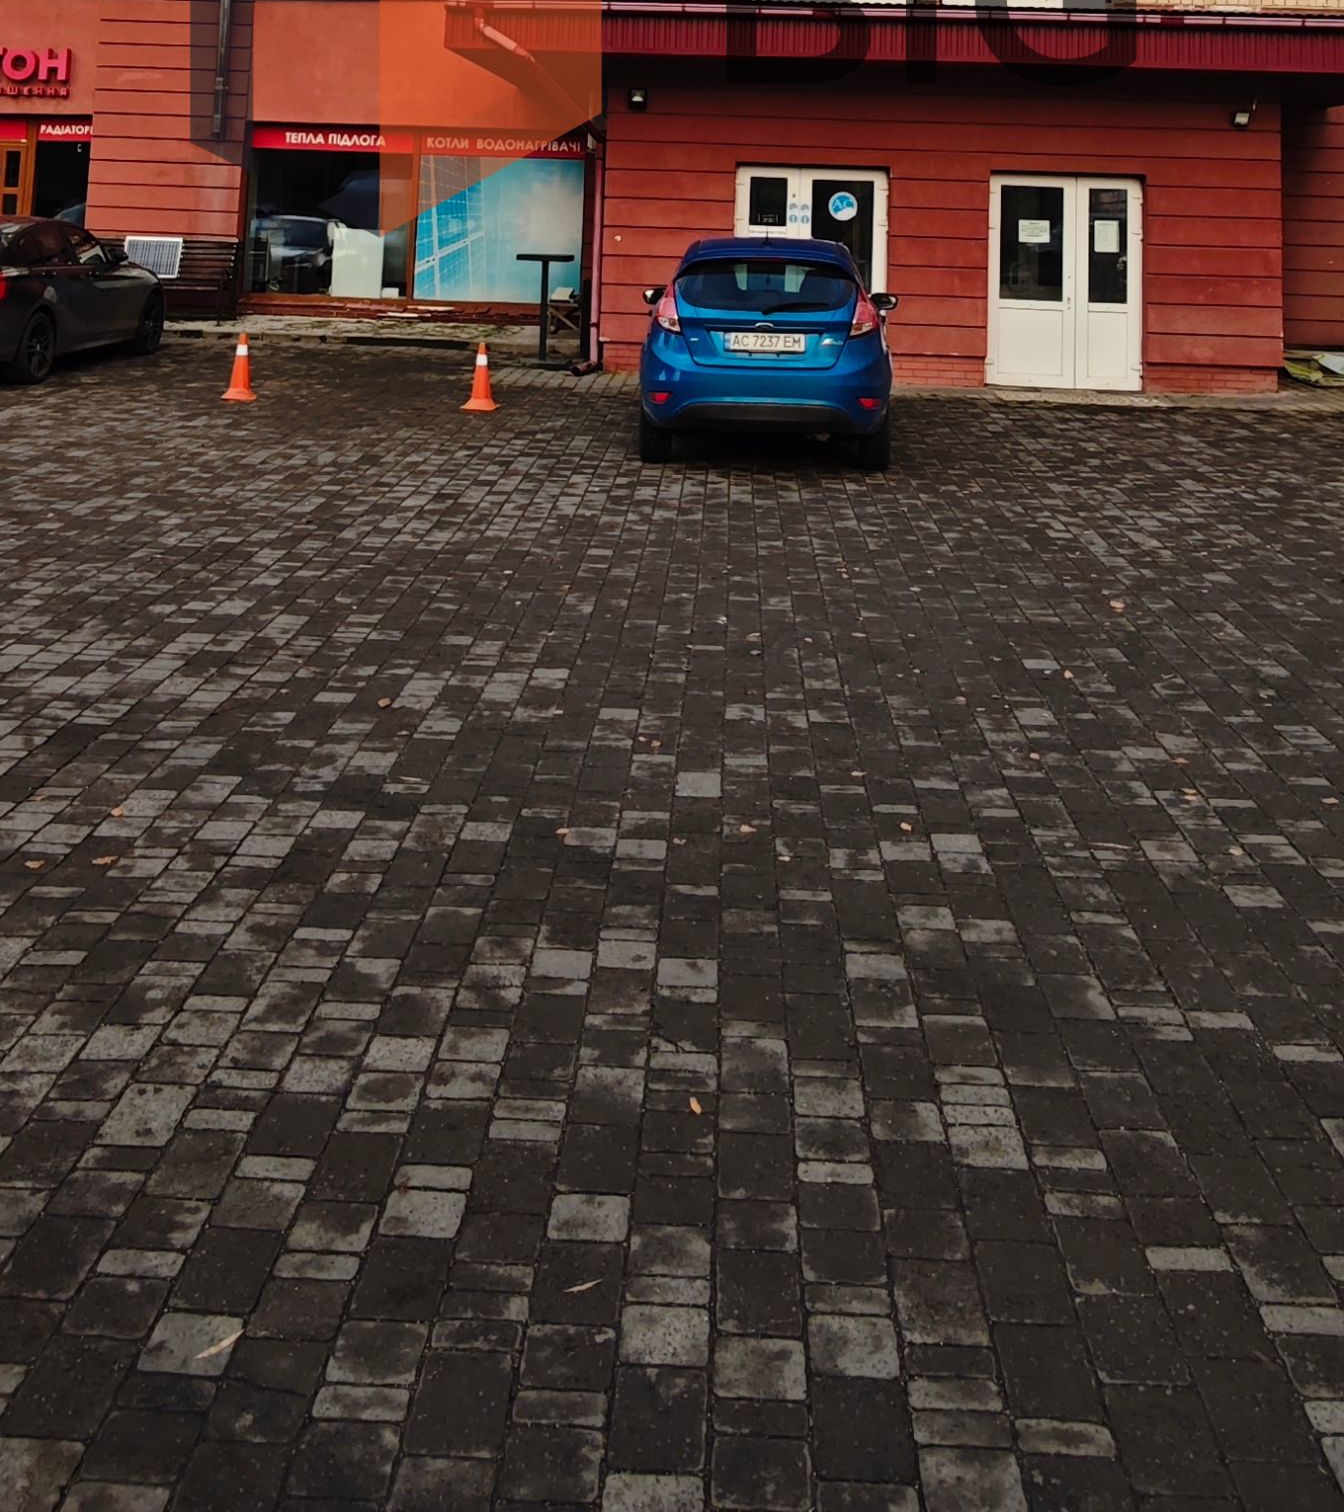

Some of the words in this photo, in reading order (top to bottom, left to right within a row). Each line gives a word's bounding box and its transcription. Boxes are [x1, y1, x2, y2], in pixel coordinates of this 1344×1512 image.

[284, 131, 325, 145] ТЕПЛА
[328, 132, 386, 147] ПІДЛОГА
[426, 136, 469, 149] КОТЛИ
[476, 138, 581, 153] ВОДОНАГРІВАЧІ
[732, 335, 750, 347] AC
[752, 335, 781, 348] 7237
[783, 336, 801, 348] EM
